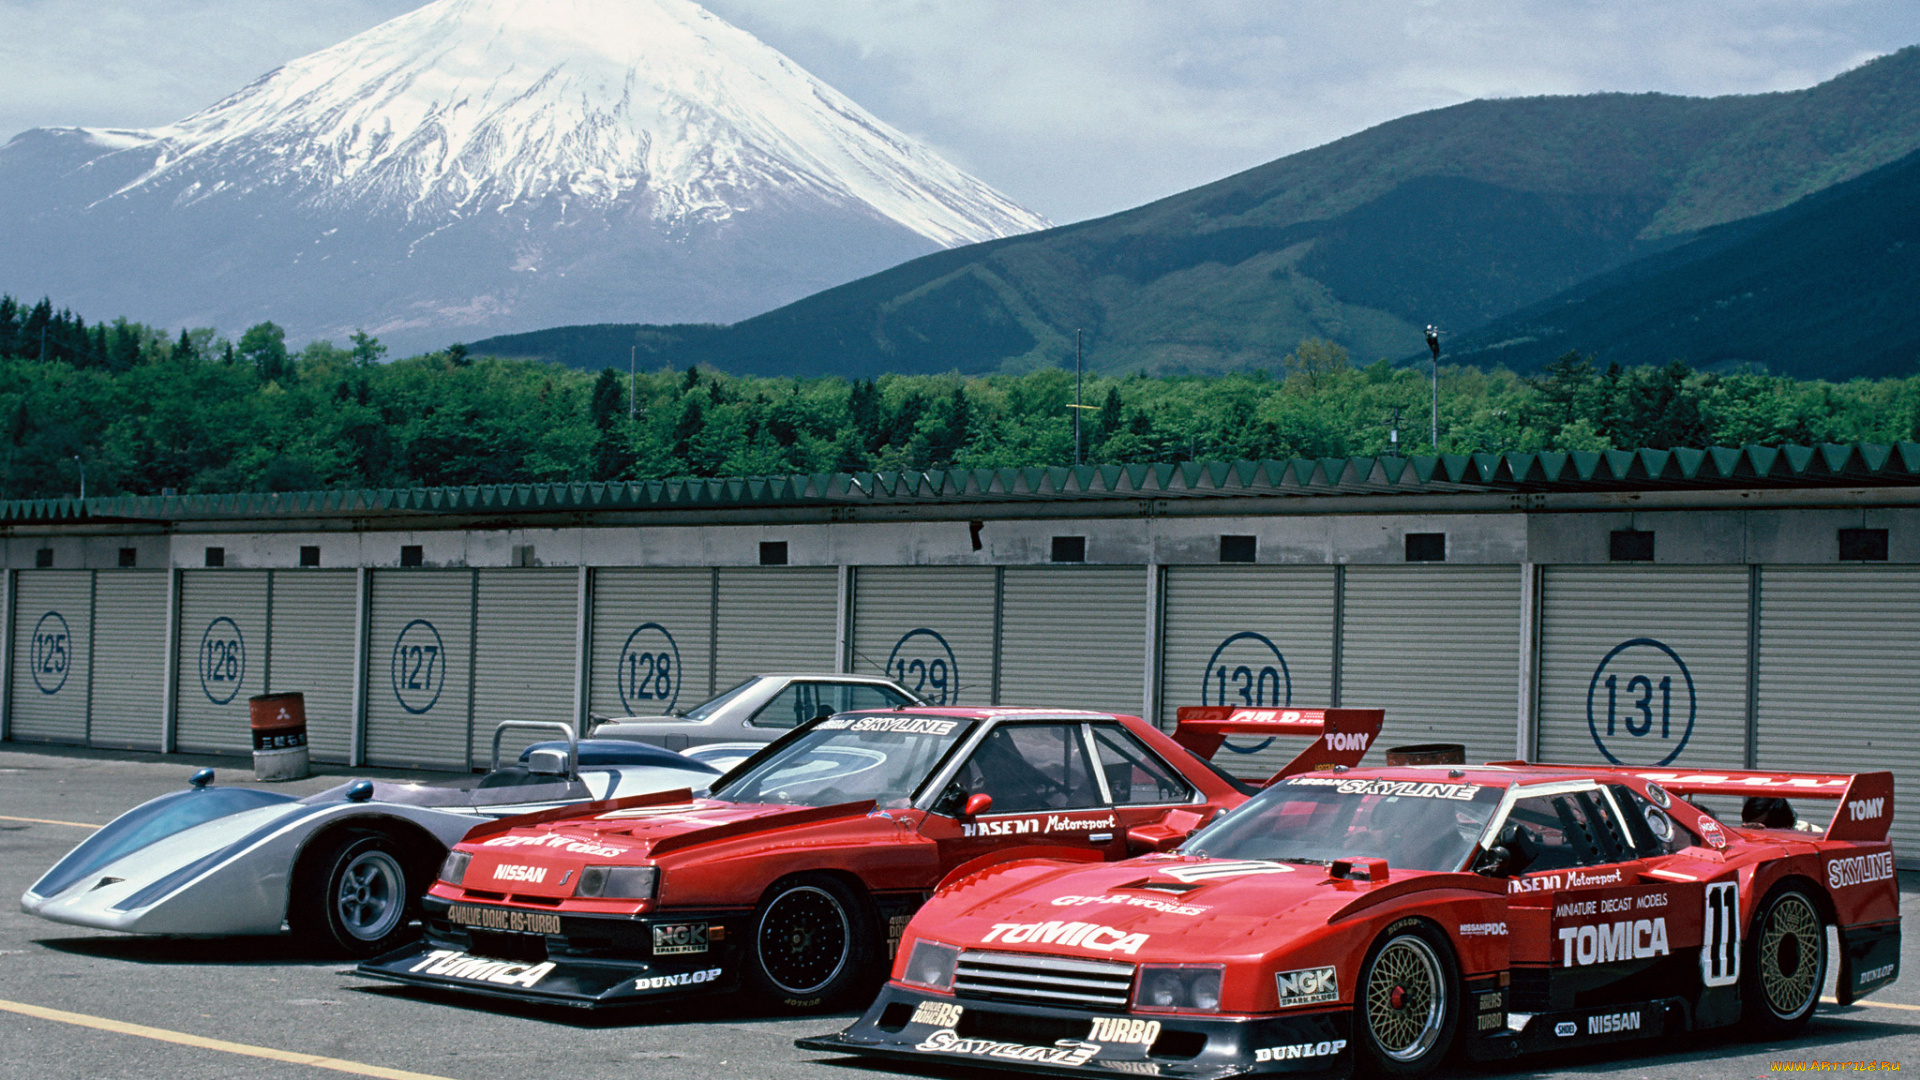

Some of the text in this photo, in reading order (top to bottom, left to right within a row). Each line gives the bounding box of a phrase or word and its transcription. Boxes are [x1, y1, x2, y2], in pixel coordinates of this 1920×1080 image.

[36, 633, 66, 673] 125
[206, 640, 238, 681] 126
[401, 645, 438, 690] 127
[628, 652, 671, 701] 128
[1216, 665, 1280, 707] 130
[1604, 674, 1672, 739] 131
[850, 716, 958, 735] SKYLINE
[1324, 732, 1369, 751] TOMY
[1336, 779, 1480, 801] SKYLINE
[1848, 796, 1885, 821] TOMY
[1044, 814, 1115, 834] Motorsport
[493, 864, 547, 883] NISSAN
[1565, 869, 1622, 890] Motorsport
[1827, 851, 1893, 889] SKYLINE
[1555, 893, 1668, 917] MINIATURE DIECAST MODELS
[448, 904, 560, 934] 4VALVE DOHC RS-TURBO
[1460, 923, 1484, 932] NISSAN
[656, 924, 706, 946] NGK
[980, 920, 1150, 954] TOMICA
[1558, 917, 1670, 968] TOMICA
[1706, 884, 1738, 982] 11
[409, 949, 557, 988] TOMICA
[635, 968, 722, 990] DUNLOP
[1860, 963, 1895, 984] DUNLOP
[1279, 968, 1336, 997] NGK
[1281, 993, 1337, 1006] SPARK PLUGS
[911, 1009, 939, 1025] DOHC
[934, 1003, 963, 1027] RS
[1477, 1012, 1502, 1030] TURBO
[1588, 1011, 1640, 1034] NISSAN
[1088, 1017, 1162, 1045] TURBO
[1255, 1039, 1347, 1062] DUNLOP
